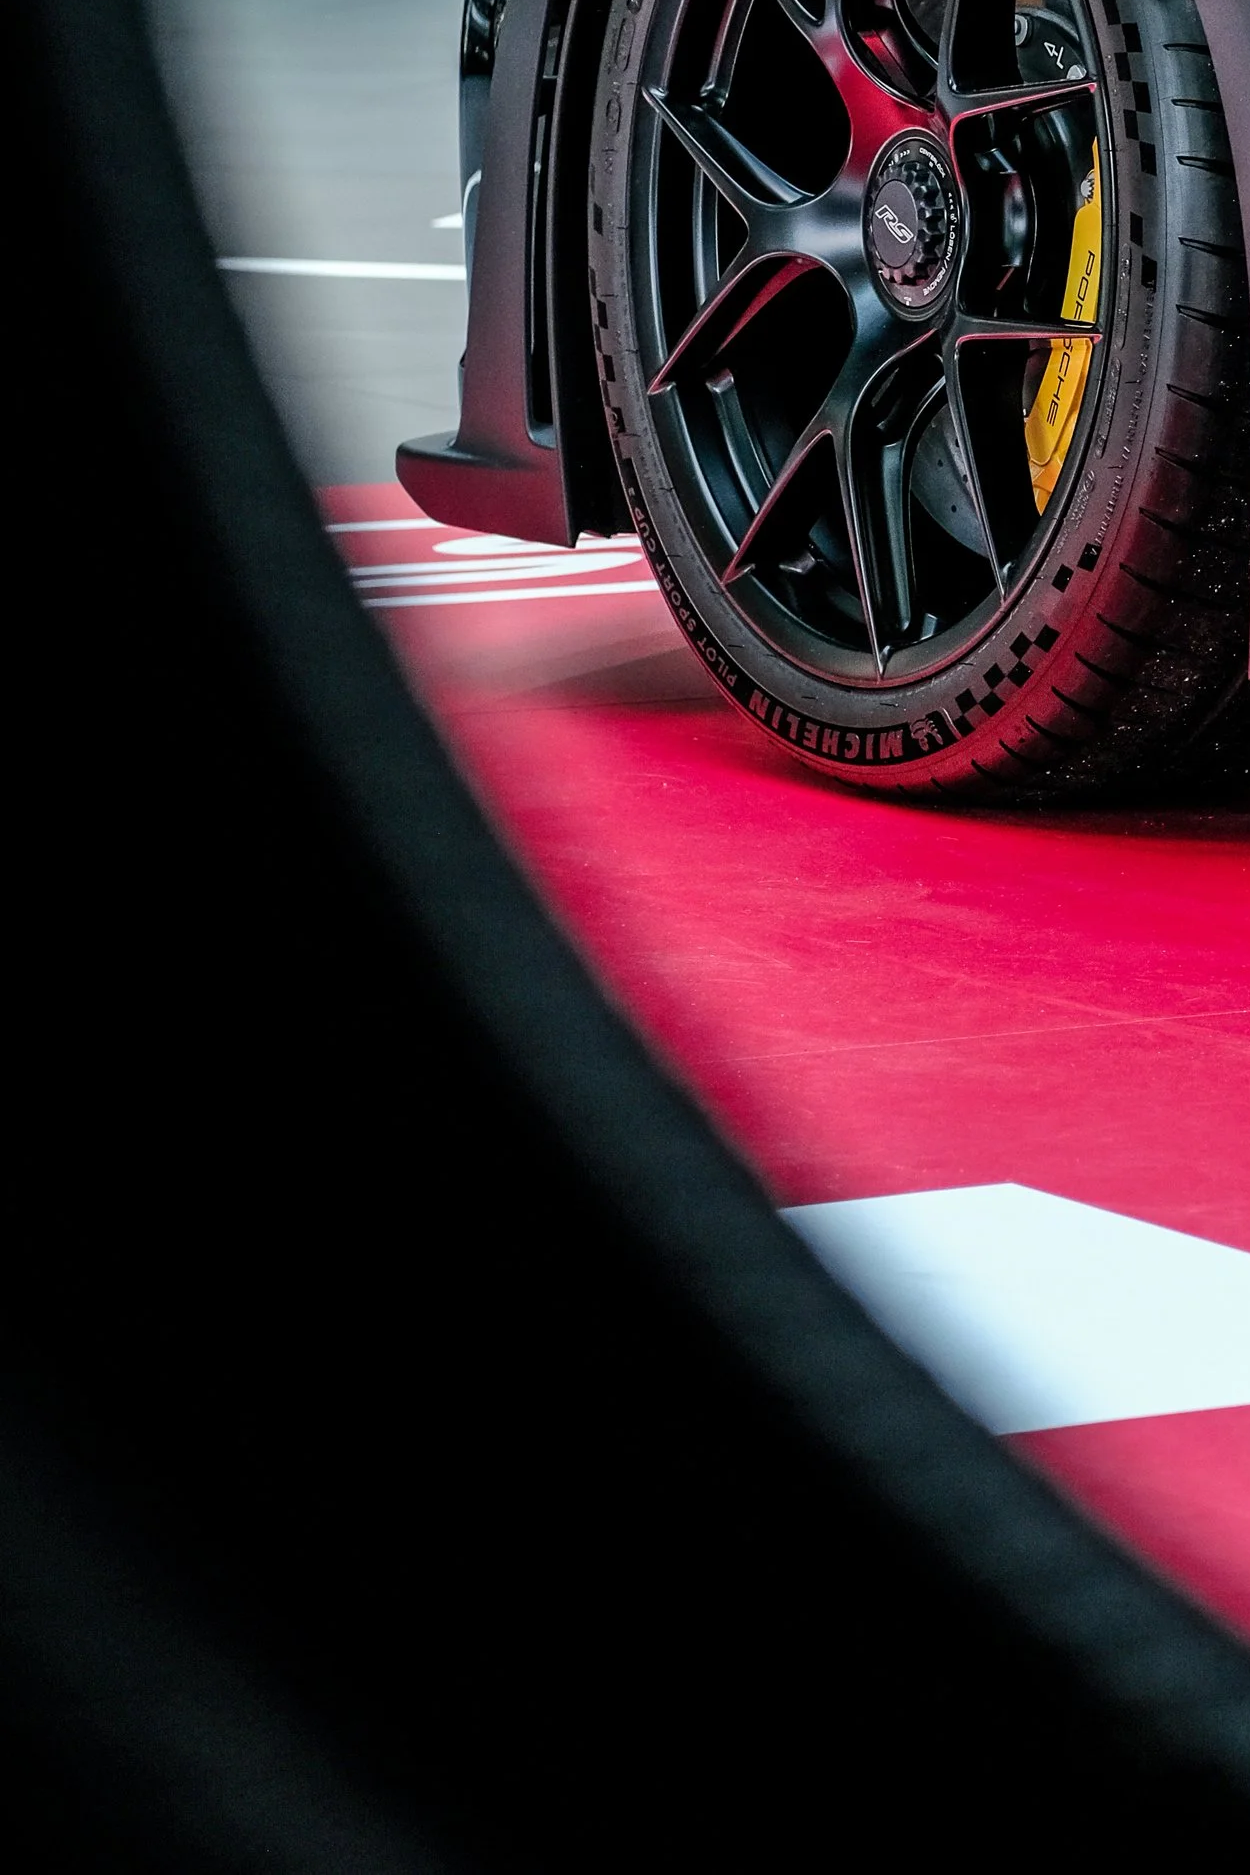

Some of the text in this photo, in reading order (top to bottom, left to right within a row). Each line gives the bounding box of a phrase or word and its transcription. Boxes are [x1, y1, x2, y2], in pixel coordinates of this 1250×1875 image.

[875, 204, 914, 244] RS
[632, 505, 657, 553] CUP
[654, 561, 698, 634] SPORT
[696, 638, 738, 689] PILOT
[748, 689, 905, 761] MICHELIN
